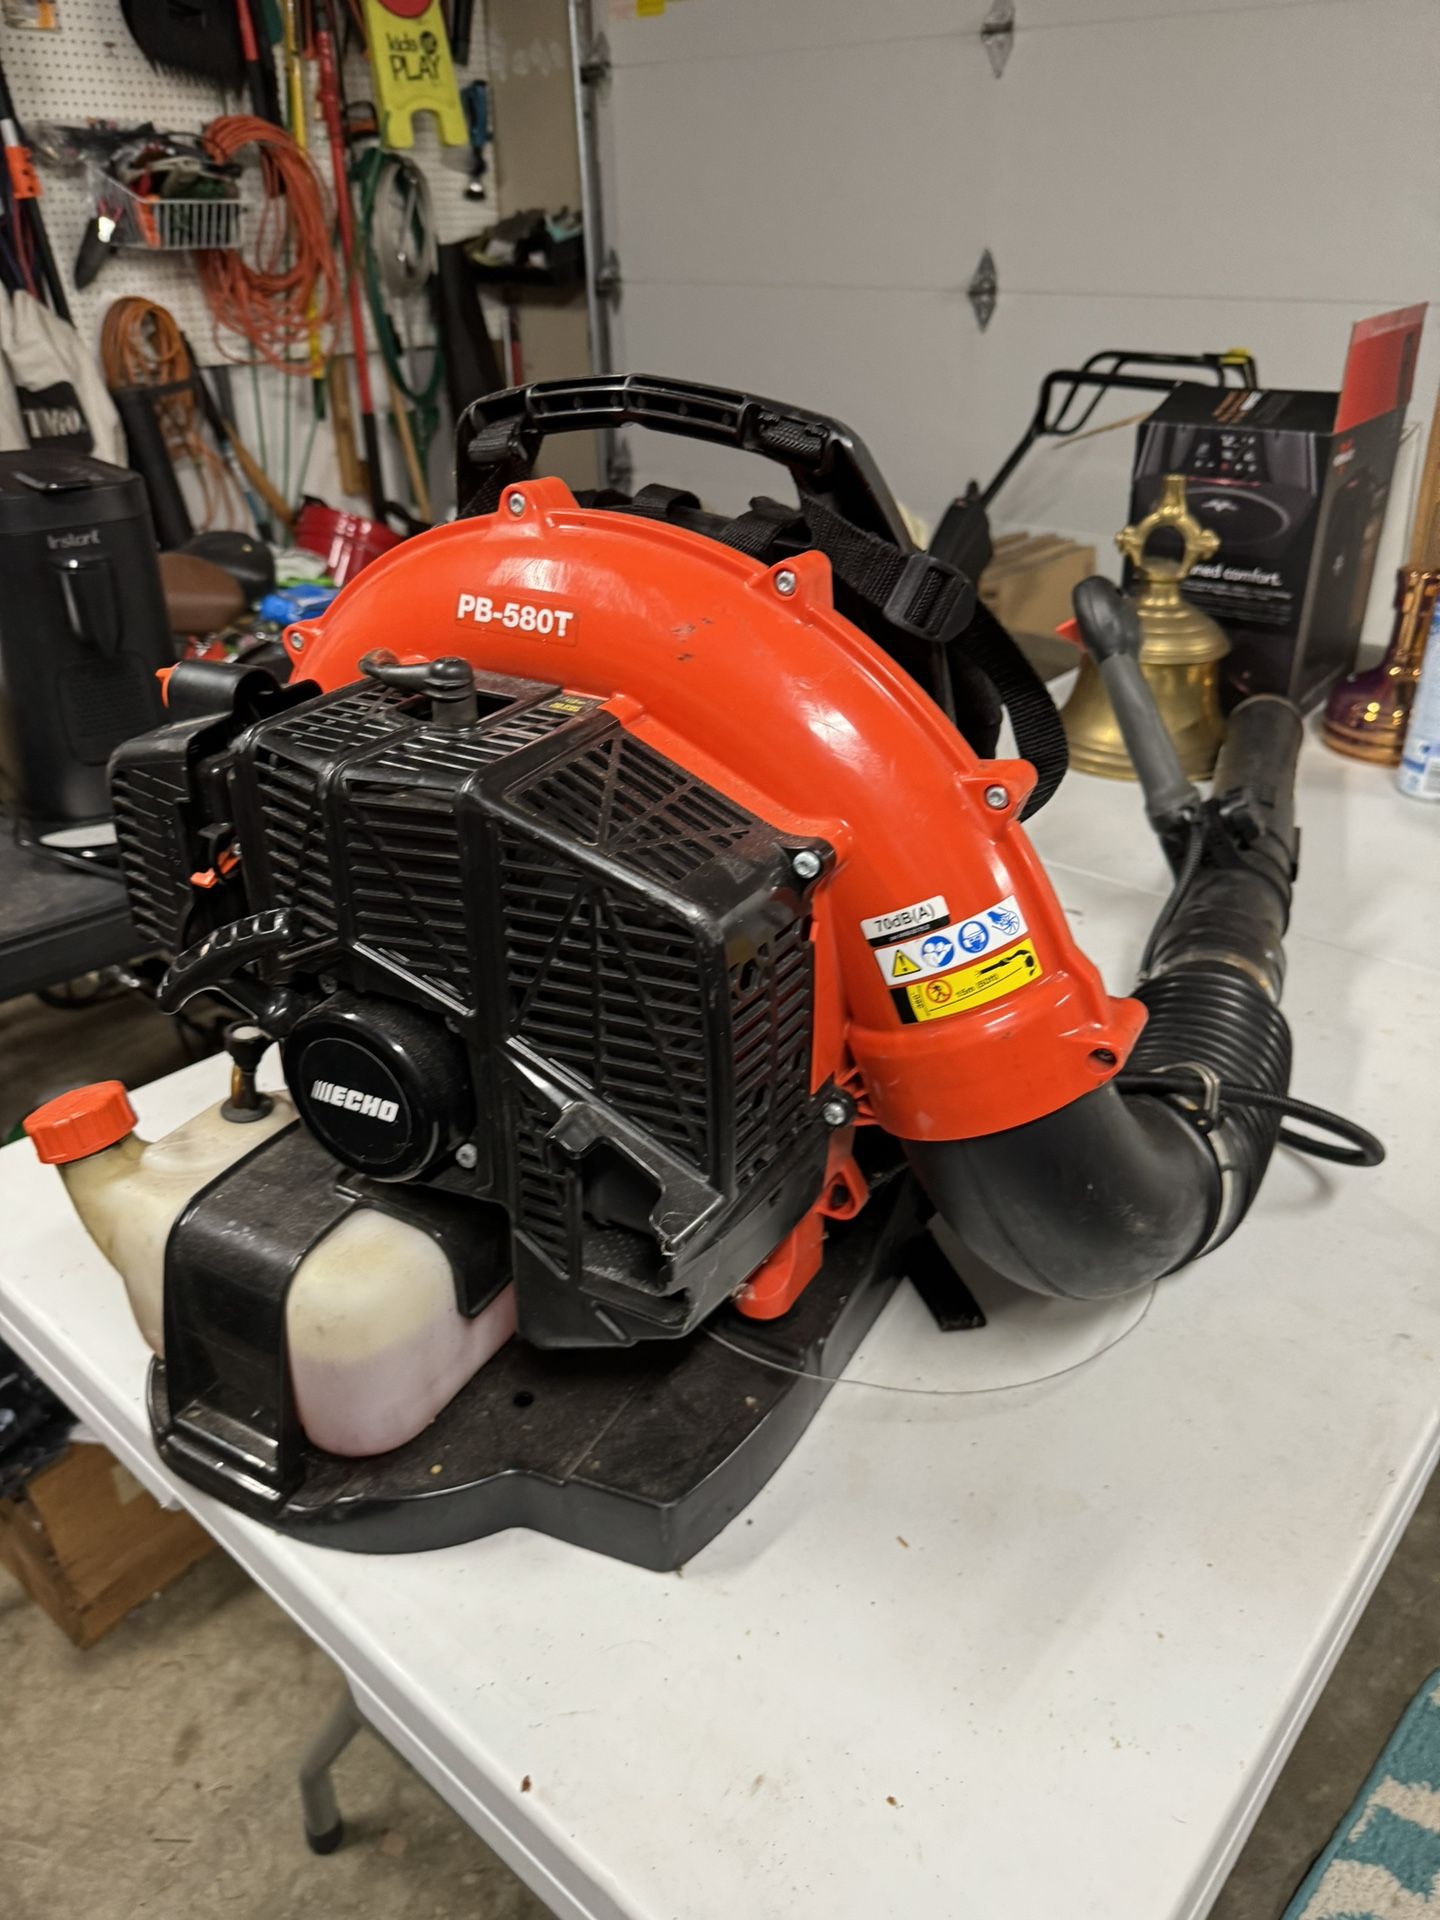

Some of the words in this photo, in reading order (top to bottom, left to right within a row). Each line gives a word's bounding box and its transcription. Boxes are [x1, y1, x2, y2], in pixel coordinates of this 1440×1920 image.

[389, 54, 440, 81] PLAY
[457, 593, 574, 637] PB-580T
[874, 903, 935, 932] 70dB(A)
[329, 1085, 400, 1123] ECHO
